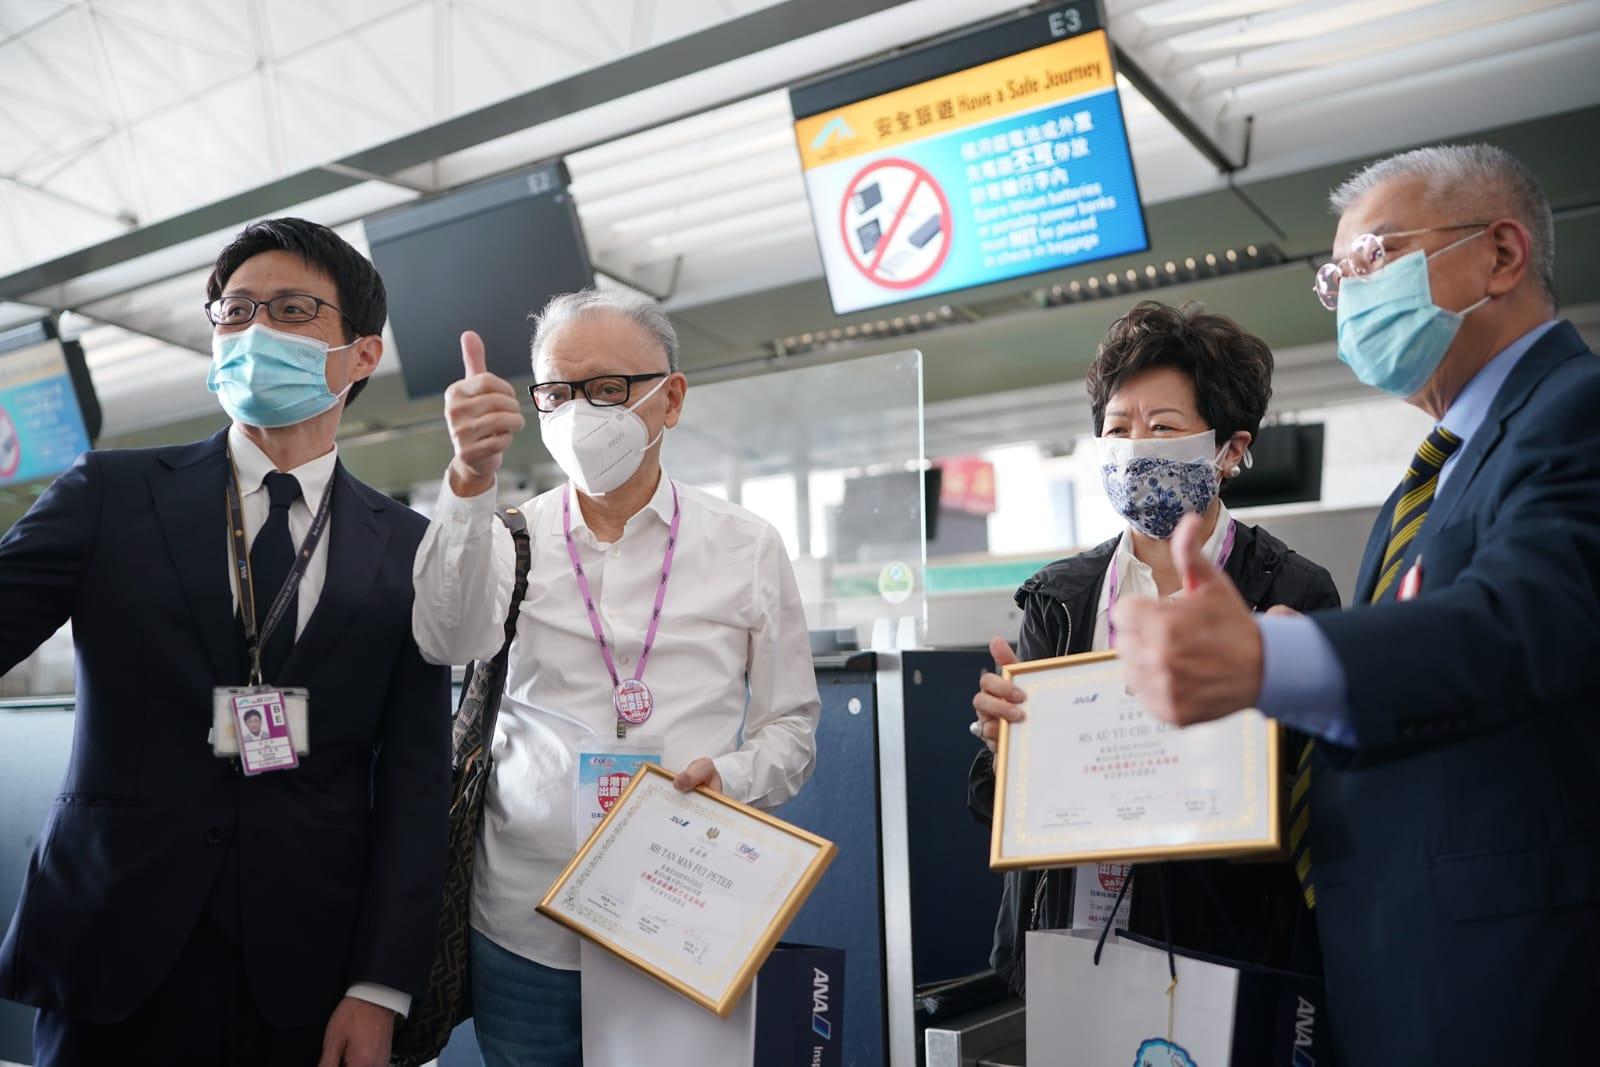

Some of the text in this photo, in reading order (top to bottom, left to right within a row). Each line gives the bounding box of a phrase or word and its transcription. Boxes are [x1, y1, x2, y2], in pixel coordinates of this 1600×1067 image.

[1049, 9, 1082, 37] E3
[1005, 74, 1039, 101] Safe
[1042, 57, 1102, 91] Journey
[273, 705, 280, 713] B
[275, 715, 282, 723] E
[661, 847, 678, 862] TAN
[676, 856, 694, 870] MAN
[706, 870, 734, 889] PETER
[813, 967, 829, 1013] ANA
[1294, 996, 1315, 1047] ANA
